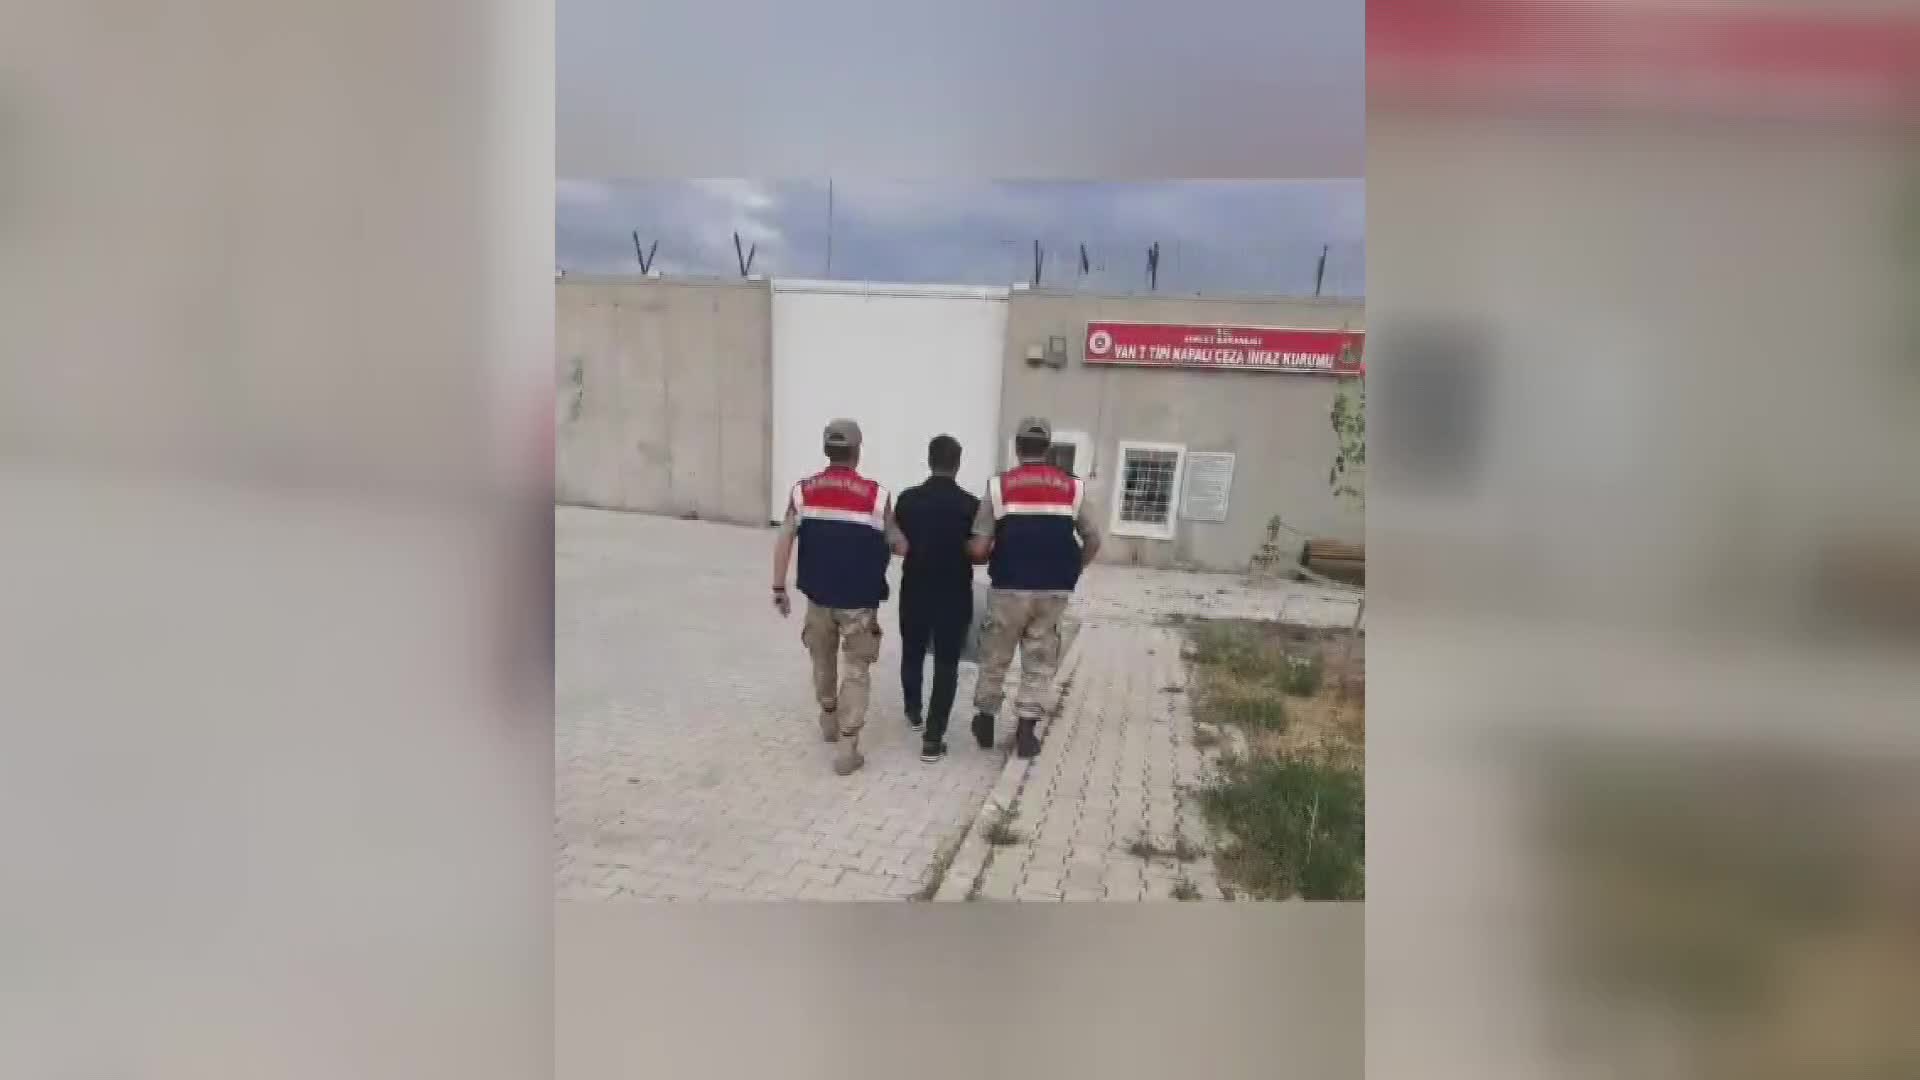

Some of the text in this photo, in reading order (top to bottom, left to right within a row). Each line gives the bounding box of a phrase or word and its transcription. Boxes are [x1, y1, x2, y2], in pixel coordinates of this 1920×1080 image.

[1115, 344, 1137, 359] VAN
[1172, 347, 1212, 362] KAPALI
[1215, 348, 1244, 364] CEZA
